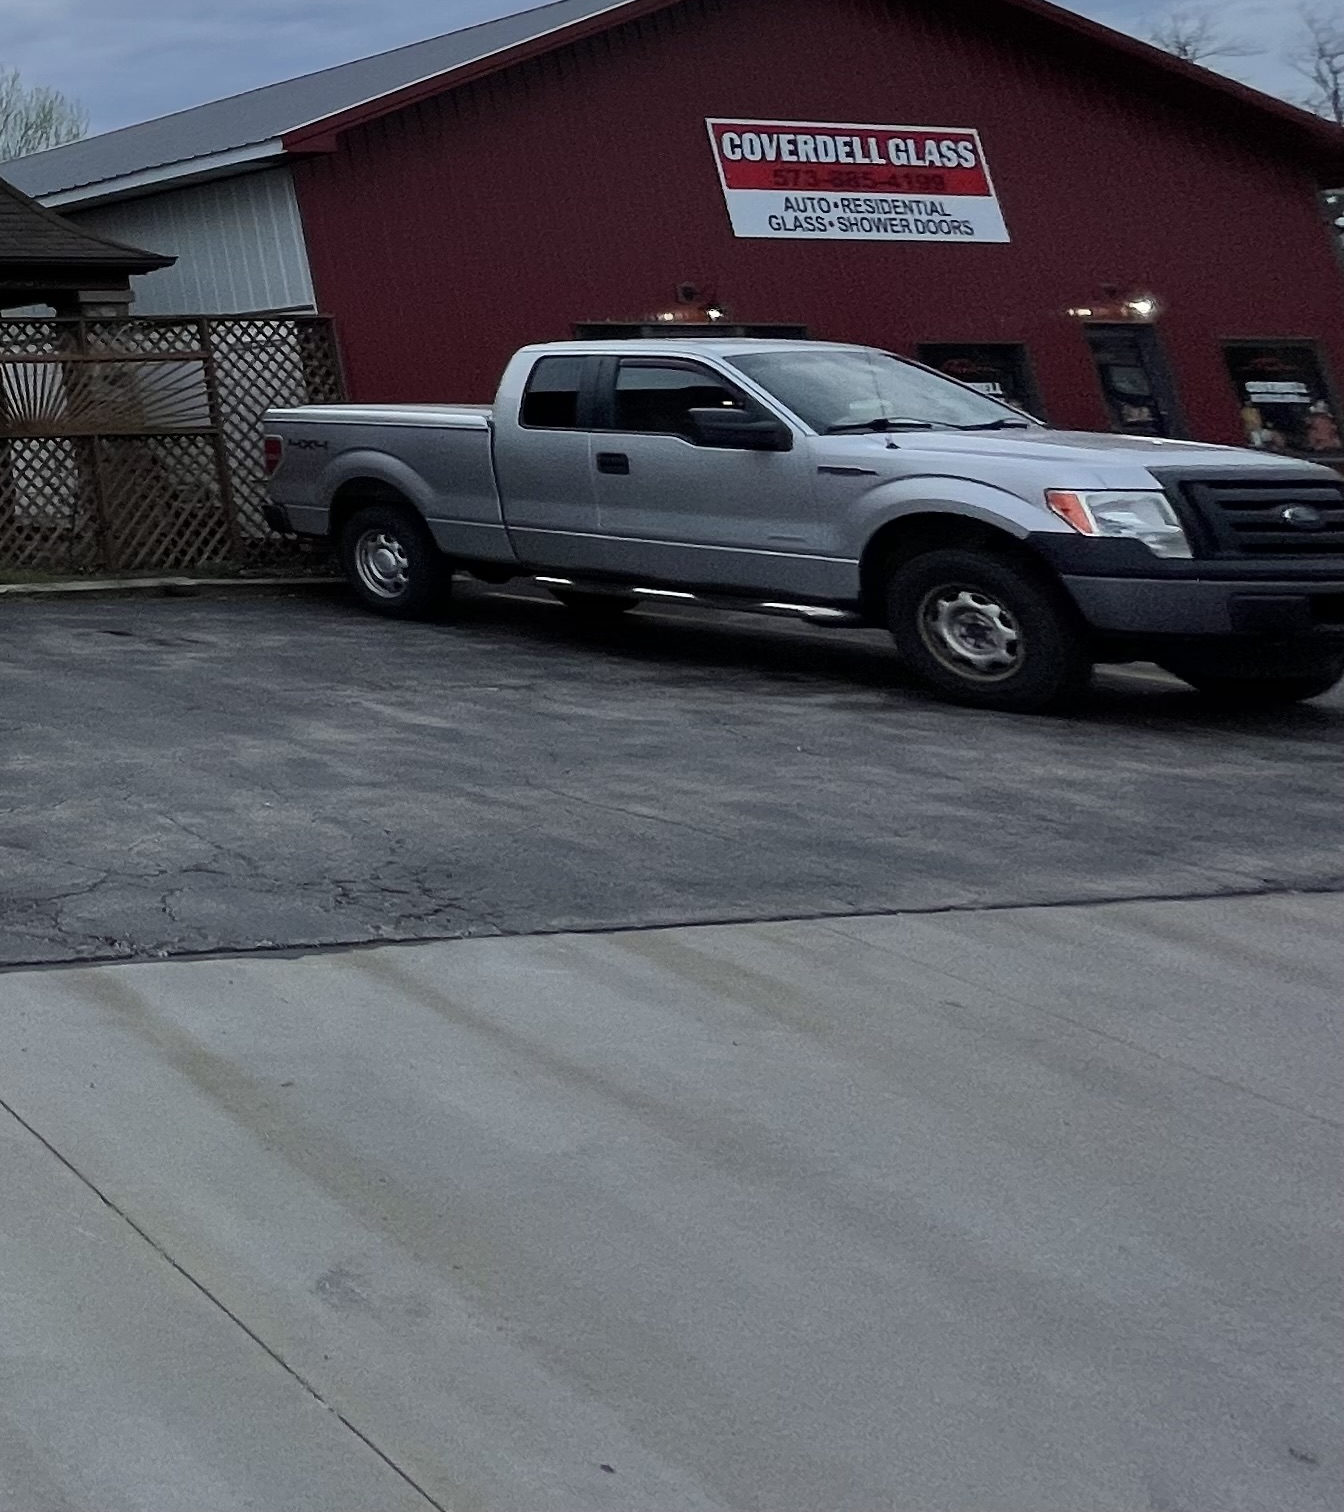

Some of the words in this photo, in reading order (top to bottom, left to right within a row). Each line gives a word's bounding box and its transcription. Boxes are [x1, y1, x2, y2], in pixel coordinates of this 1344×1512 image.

[721, 132, 886, 165] COVERDELL
[887, 138, 976, 169] GLASS
[914, 219, 975, 236] DOORS
